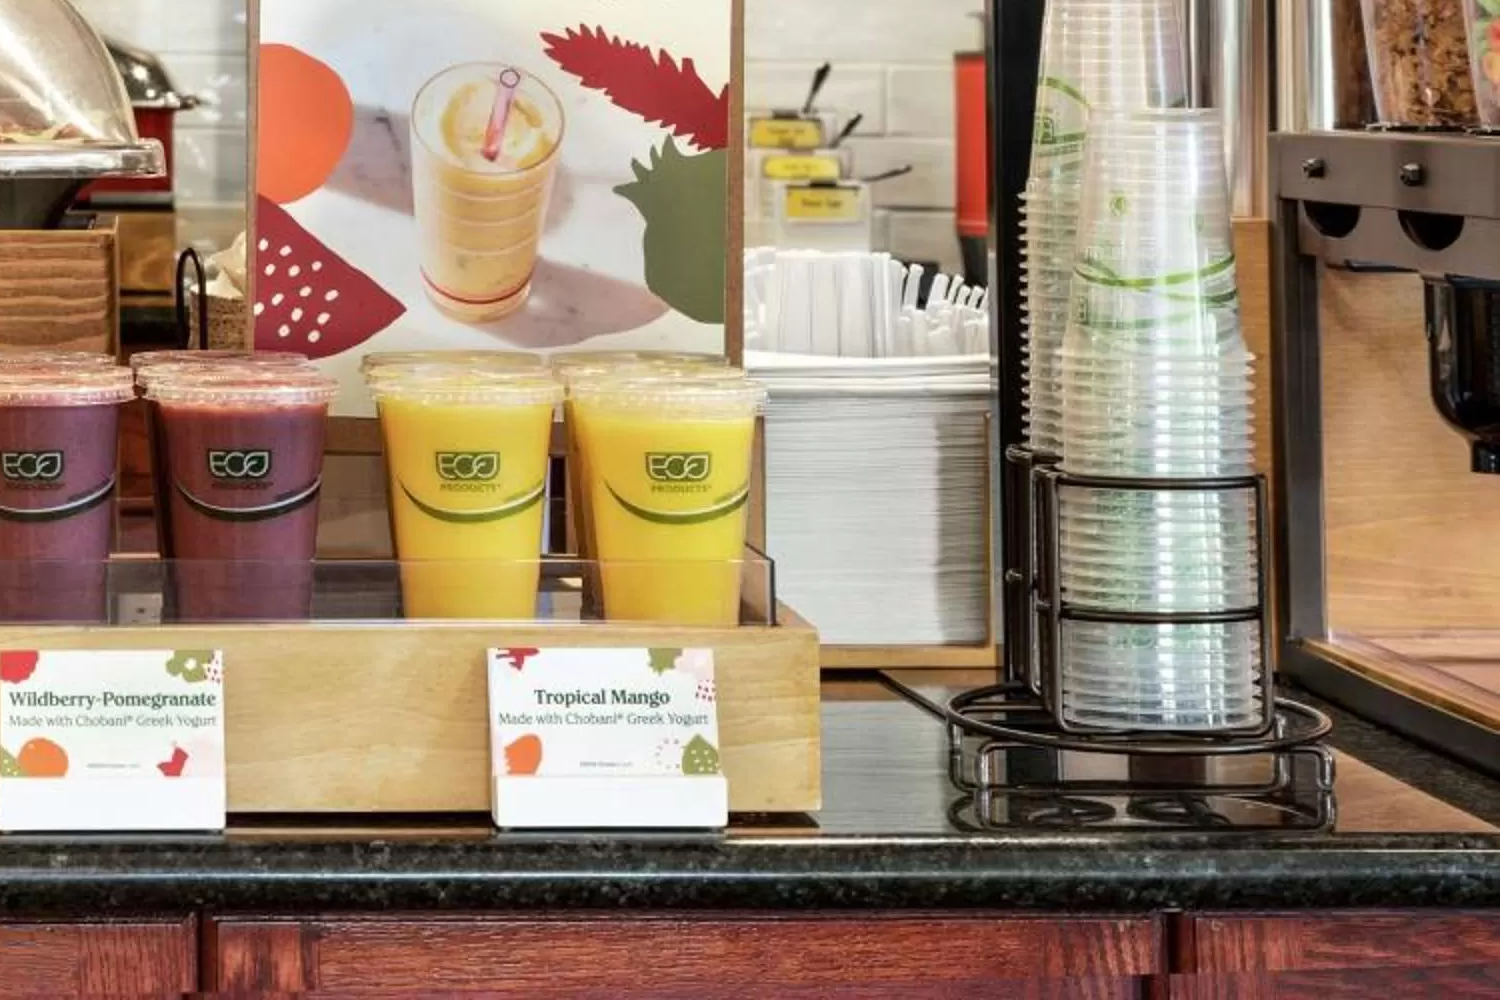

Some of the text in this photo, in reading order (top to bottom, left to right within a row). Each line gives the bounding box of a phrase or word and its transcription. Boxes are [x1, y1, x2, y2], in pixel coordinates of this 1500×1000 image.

[2, 452, 62, 479] ECO
[208, 451, 270, 479] ECO
[437, 453, 499, 480] ECO
[647, 453, 710, 481] ECO
[9, 691, 217, 710] Wildberry-Pomegranate
[534, 689, 671, 708] Tropical Mango
[9, 715, 43, 727] Made
[46, 715, 73, 727] with
[136, 715, 173, 727] Greek
[177, 716, 217, 728] Yogurt
[499, 712, 533, 725] Made
[536, 712, 563, 725] with
[627, 712, 664, 725] Greek
[667, 712, 709, 726] Yogurt
